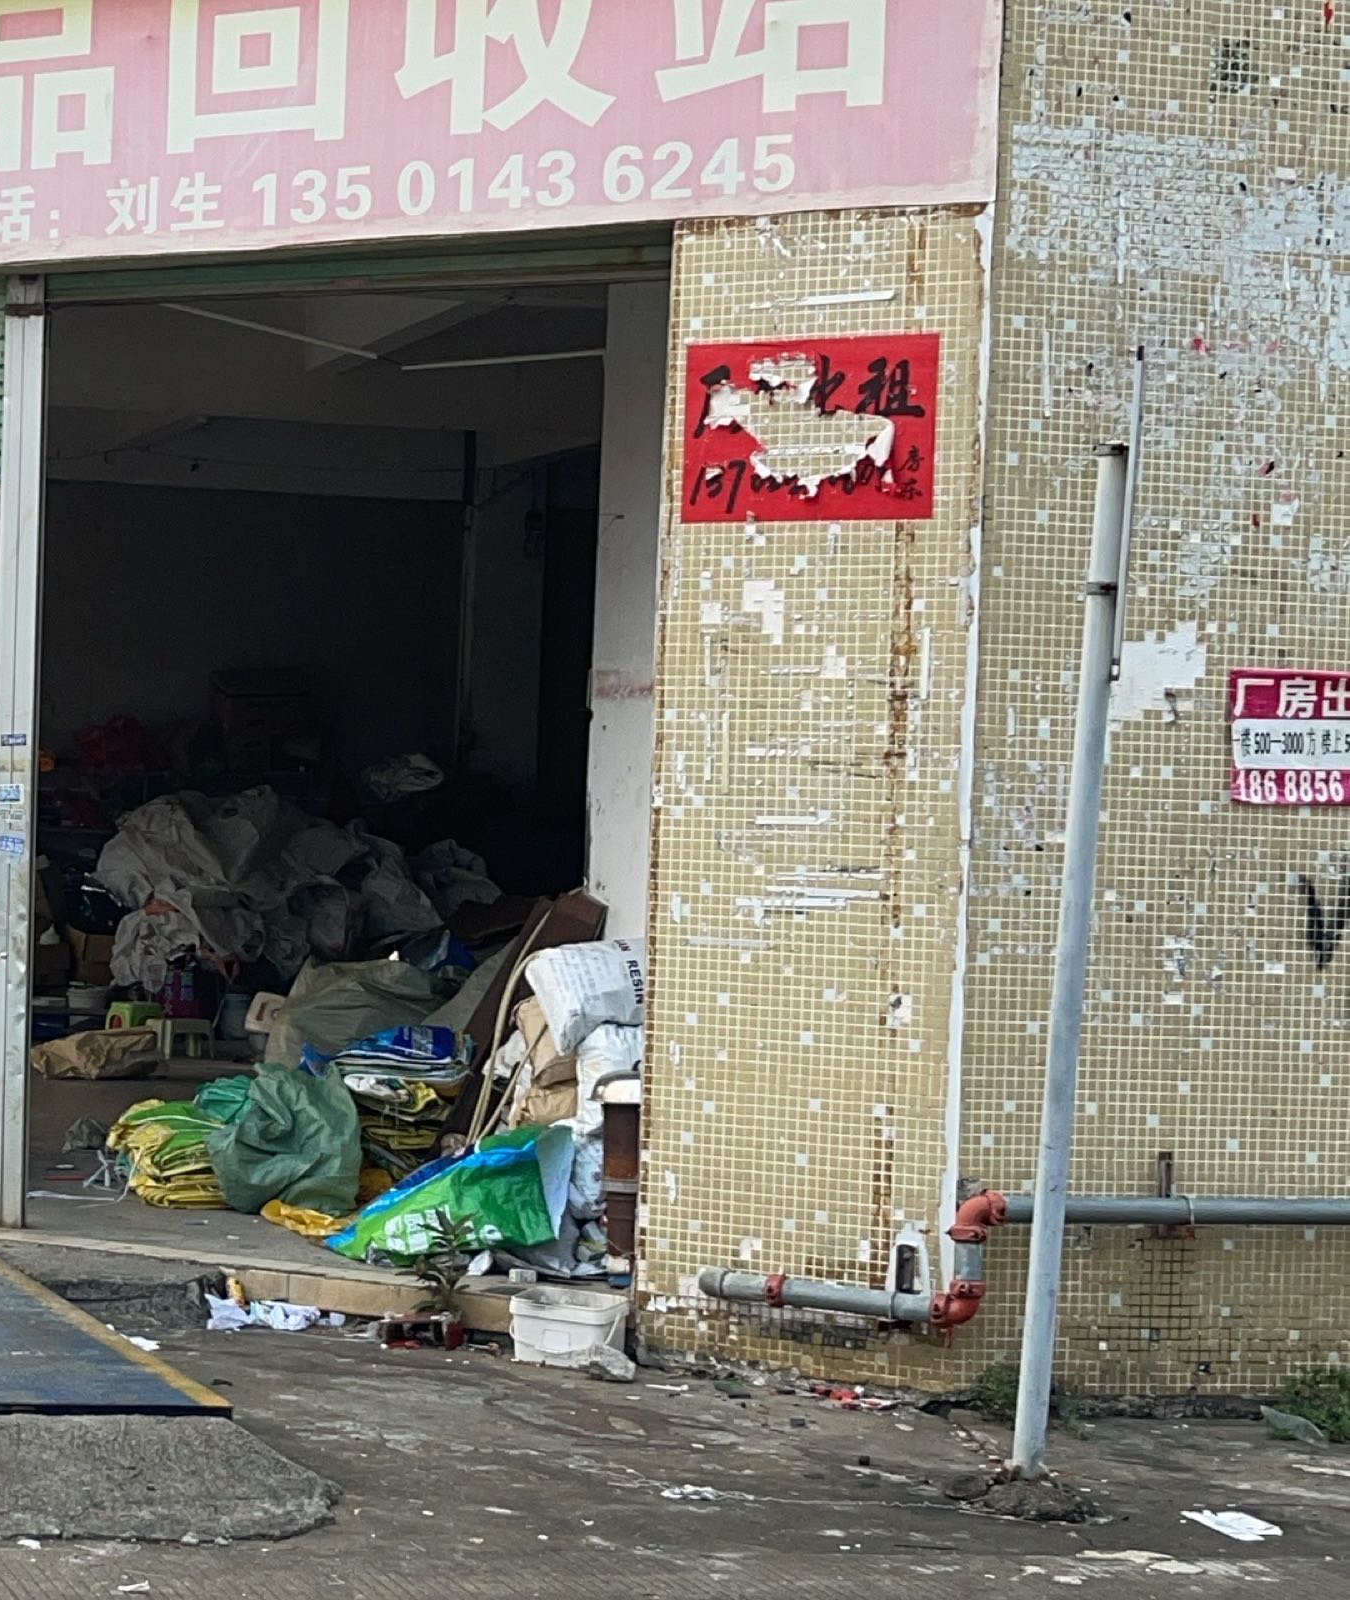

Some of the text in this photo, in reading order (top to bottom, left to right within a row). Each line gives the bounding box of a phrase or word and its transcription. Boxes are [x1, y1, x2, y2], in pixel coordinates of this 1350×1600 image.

[252, 167, 372, 227] 135
[397, 148, 577, 213] 0143
[603, 134, 798, 204] 6245
[1236, 770, 1345, 803] 186 8856
[626, 959, 644, 1005] RESIN
